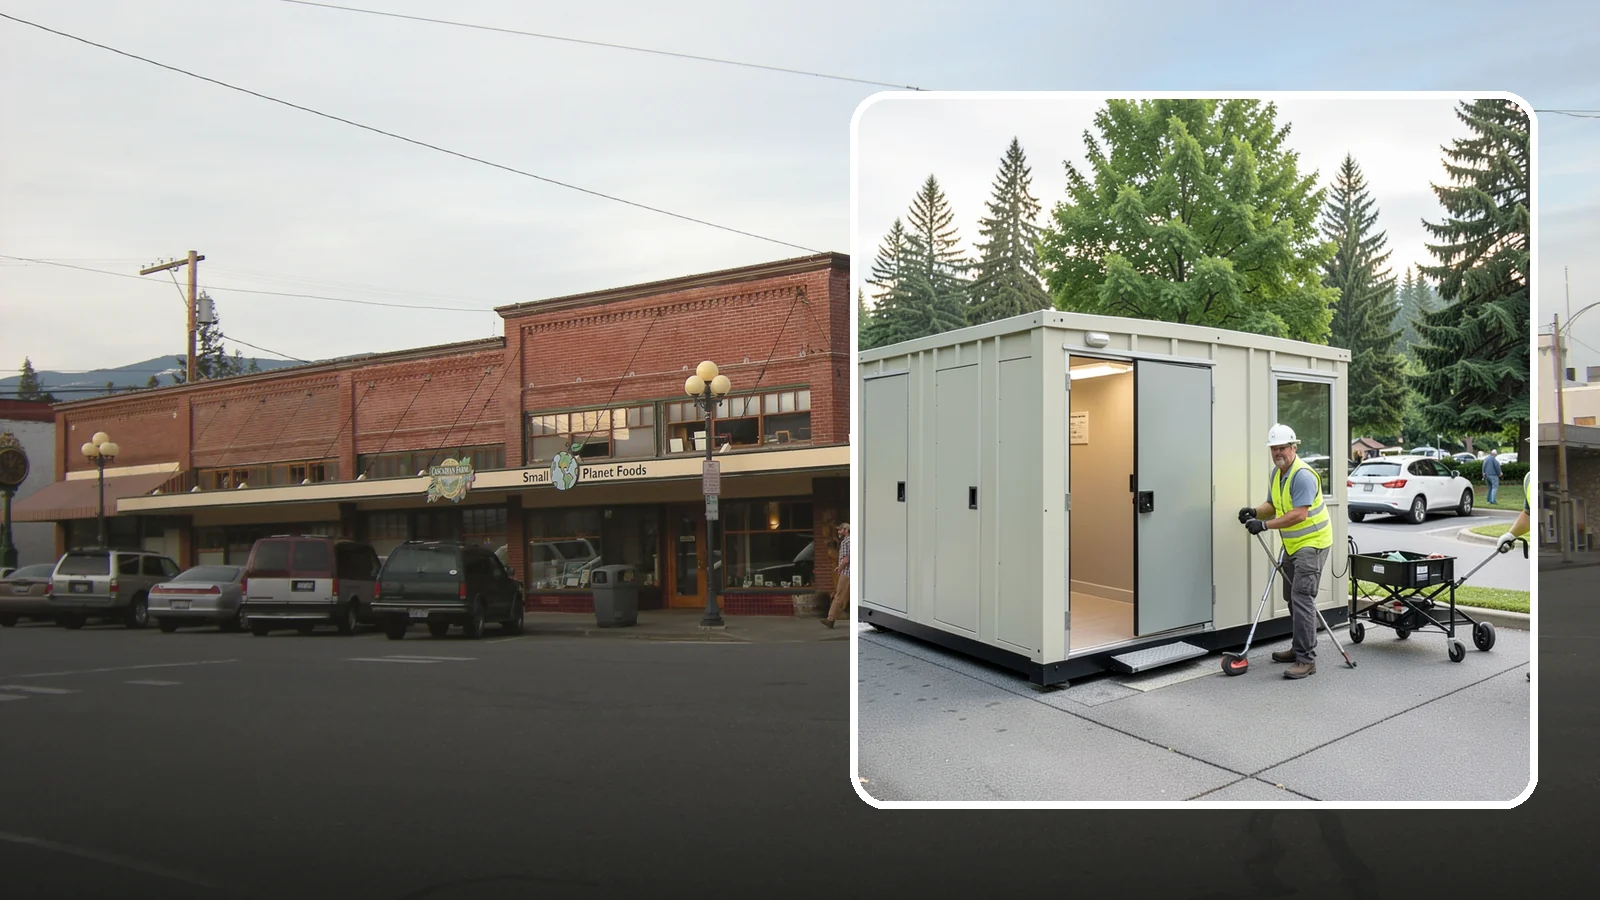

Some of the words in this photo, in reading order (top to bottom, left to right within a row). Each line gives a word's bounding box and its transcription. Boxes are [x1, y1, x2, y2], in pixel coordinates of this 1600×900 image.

[523, 471, 549, 483] Small
[582, 467, 614, 479] Planet
[617, 464, 647, 477] Foods
